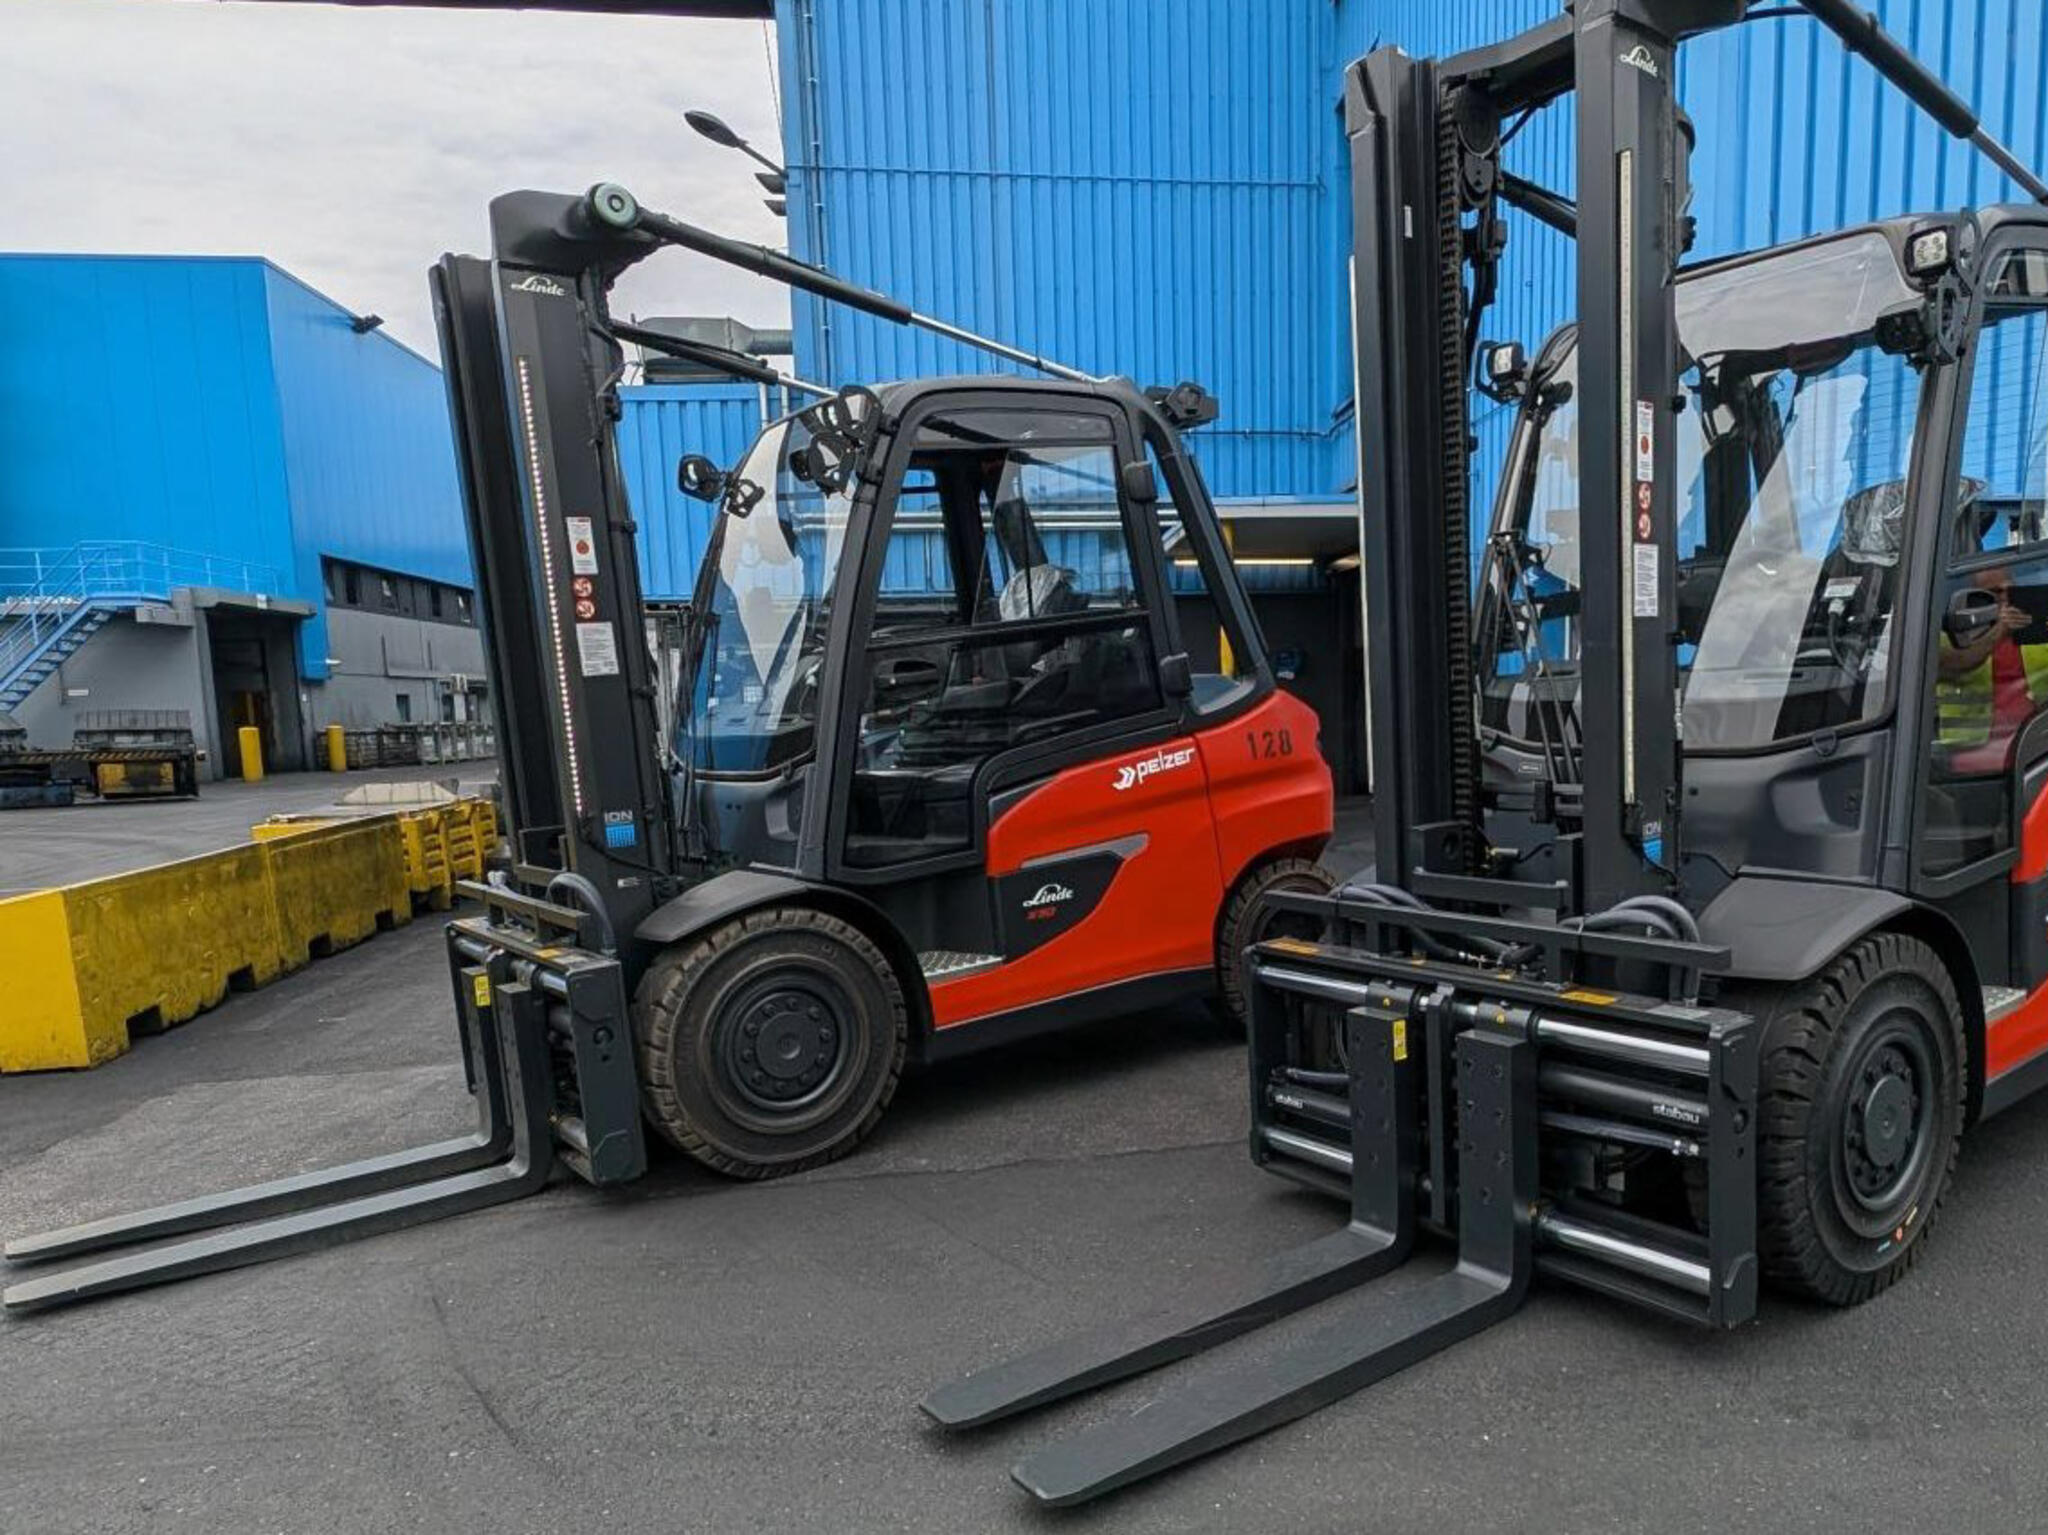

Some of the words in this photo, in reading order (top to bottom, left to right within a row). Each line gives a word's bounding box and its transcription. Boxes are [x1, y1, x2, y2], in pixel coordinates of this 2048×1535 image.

[1620, 45, 1658, 78] Linde
[511, 275, 566, 297] Linde
[1247, 730, 1293, 760] 128
[604, 810, 634, 823] ION
[1022, 883, 1073, 907] Linde
[1652, 1104, 1700, 1124] stabau
